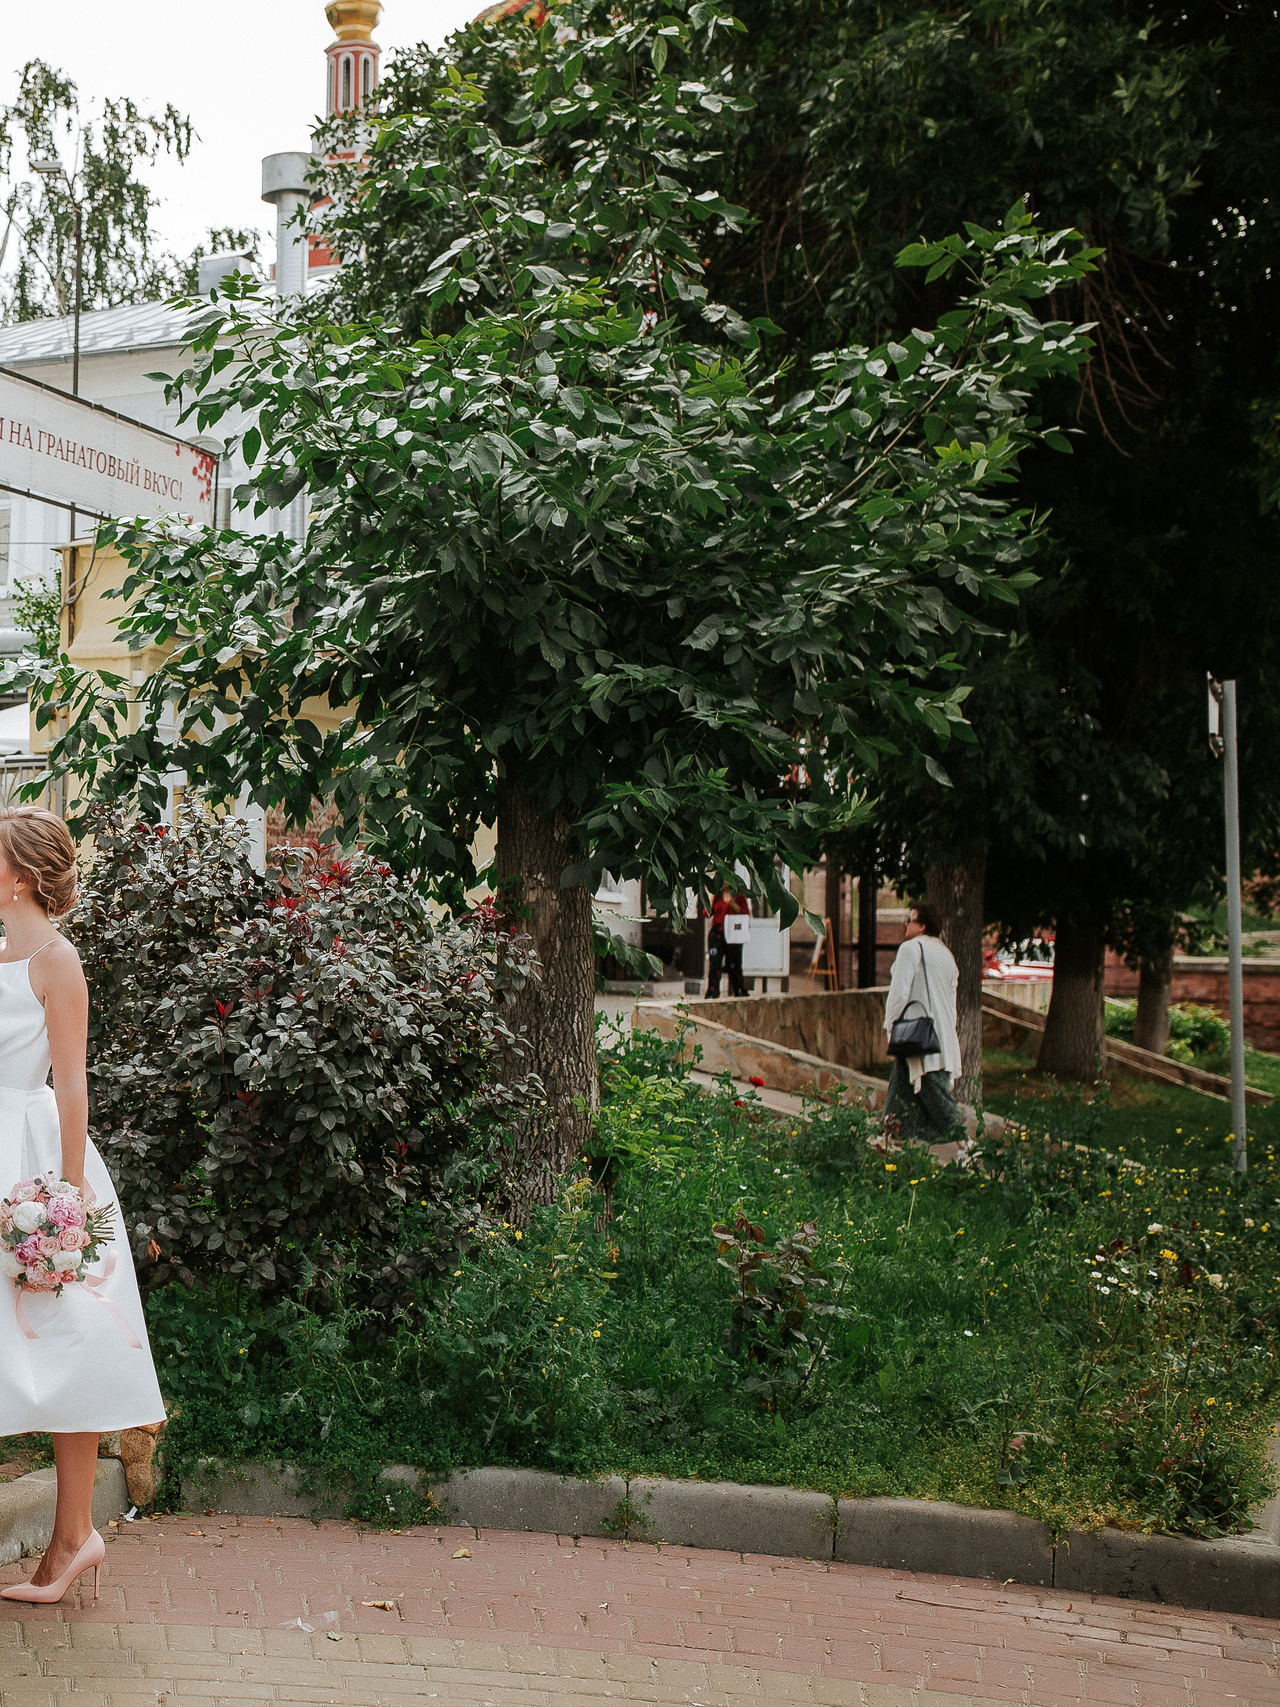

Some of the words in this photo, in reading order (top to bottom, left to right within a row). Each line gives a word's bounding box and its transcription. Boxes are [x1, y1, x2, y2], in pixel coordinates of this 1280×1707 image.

[9, 420, 34, 450] НА
[37, 430, 141, 487] ГРАНАТОВЫЙ
[144, 468, 183, 501] ВКУС!
